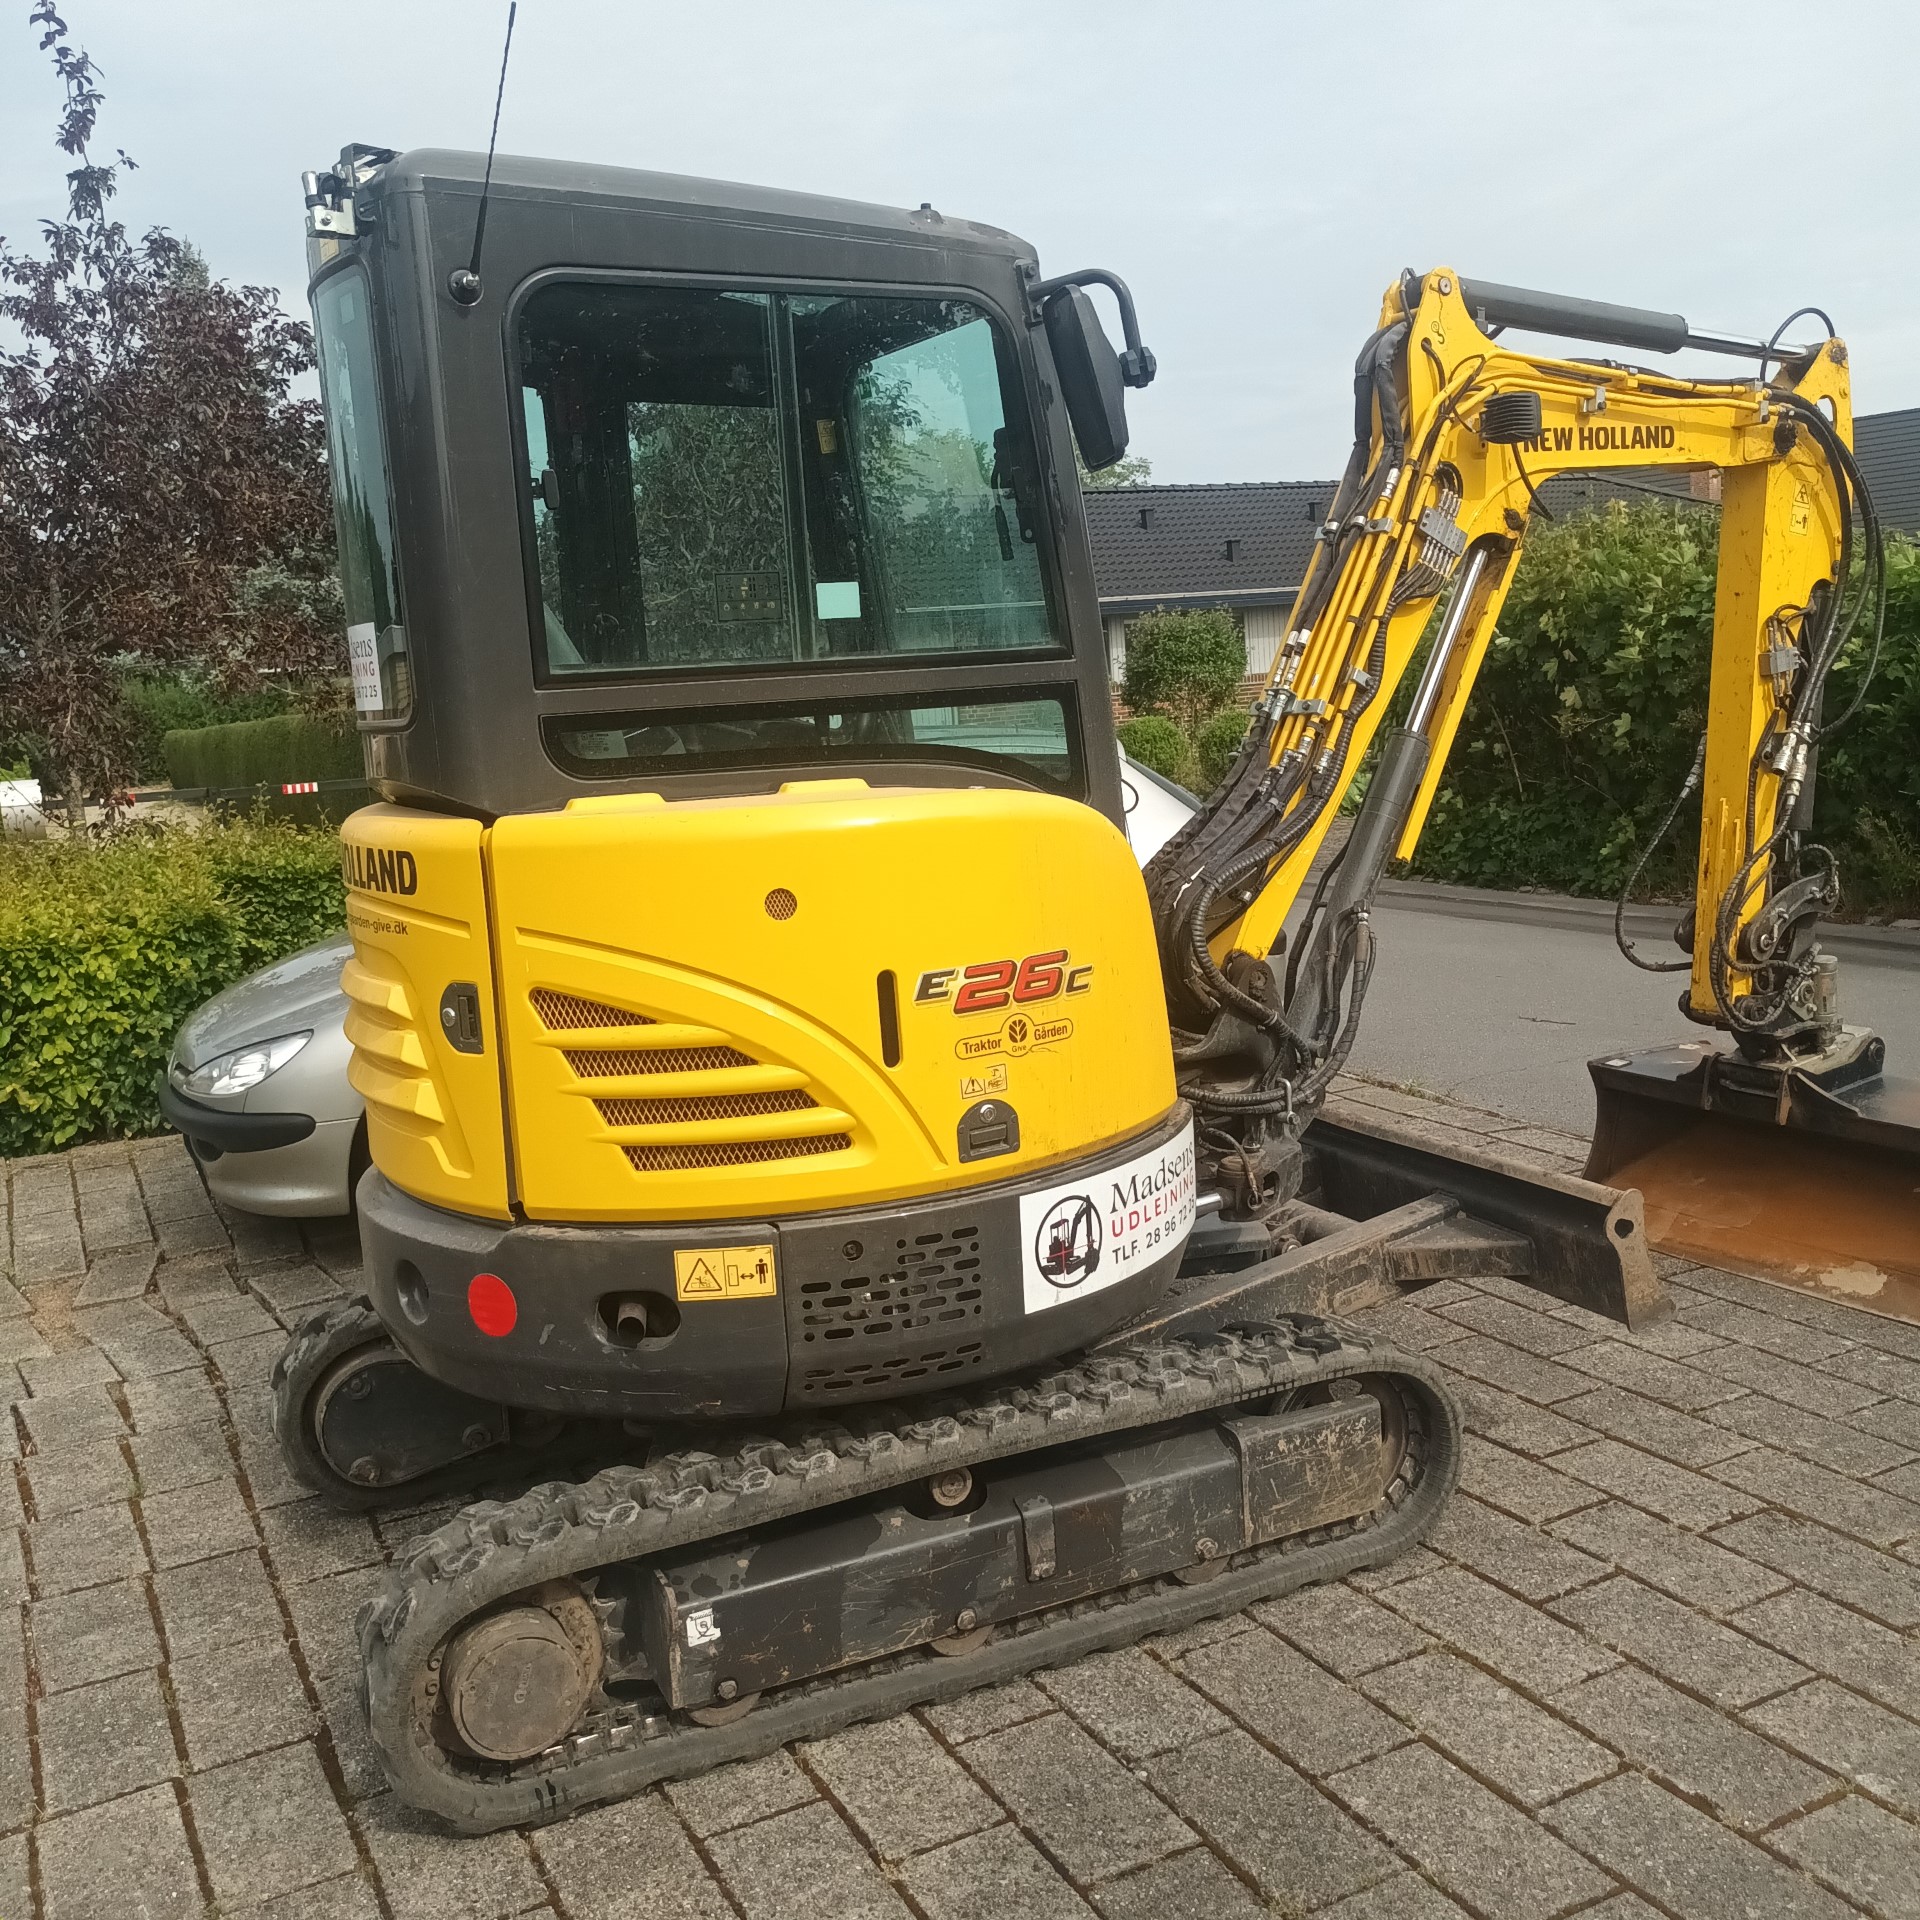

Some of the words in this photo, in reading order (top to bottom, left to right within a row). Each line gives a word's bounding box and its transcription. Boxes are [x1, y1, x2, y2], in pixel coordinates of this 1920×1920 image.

[1578, 425, 1675, 451] HOLLAND
[369, 685, 378, 698] 25
[342, 842, 417, 895] OLLAND
[963, 1038, 1002, 1054] Traktor
[1034, 1025, 1068, 1041] Gården
[1110, 1141, 1193, 1214] Madsens
[1112, 1167, 1194, 1238] UDLEJNING
[1112, 1239, 1141, 1264] TLF.
[1145, 1227, 1161, 1249] 28
[1164, 1215, 1176, 1237] 96
[1178, 1204, 1187, 1225] 72
